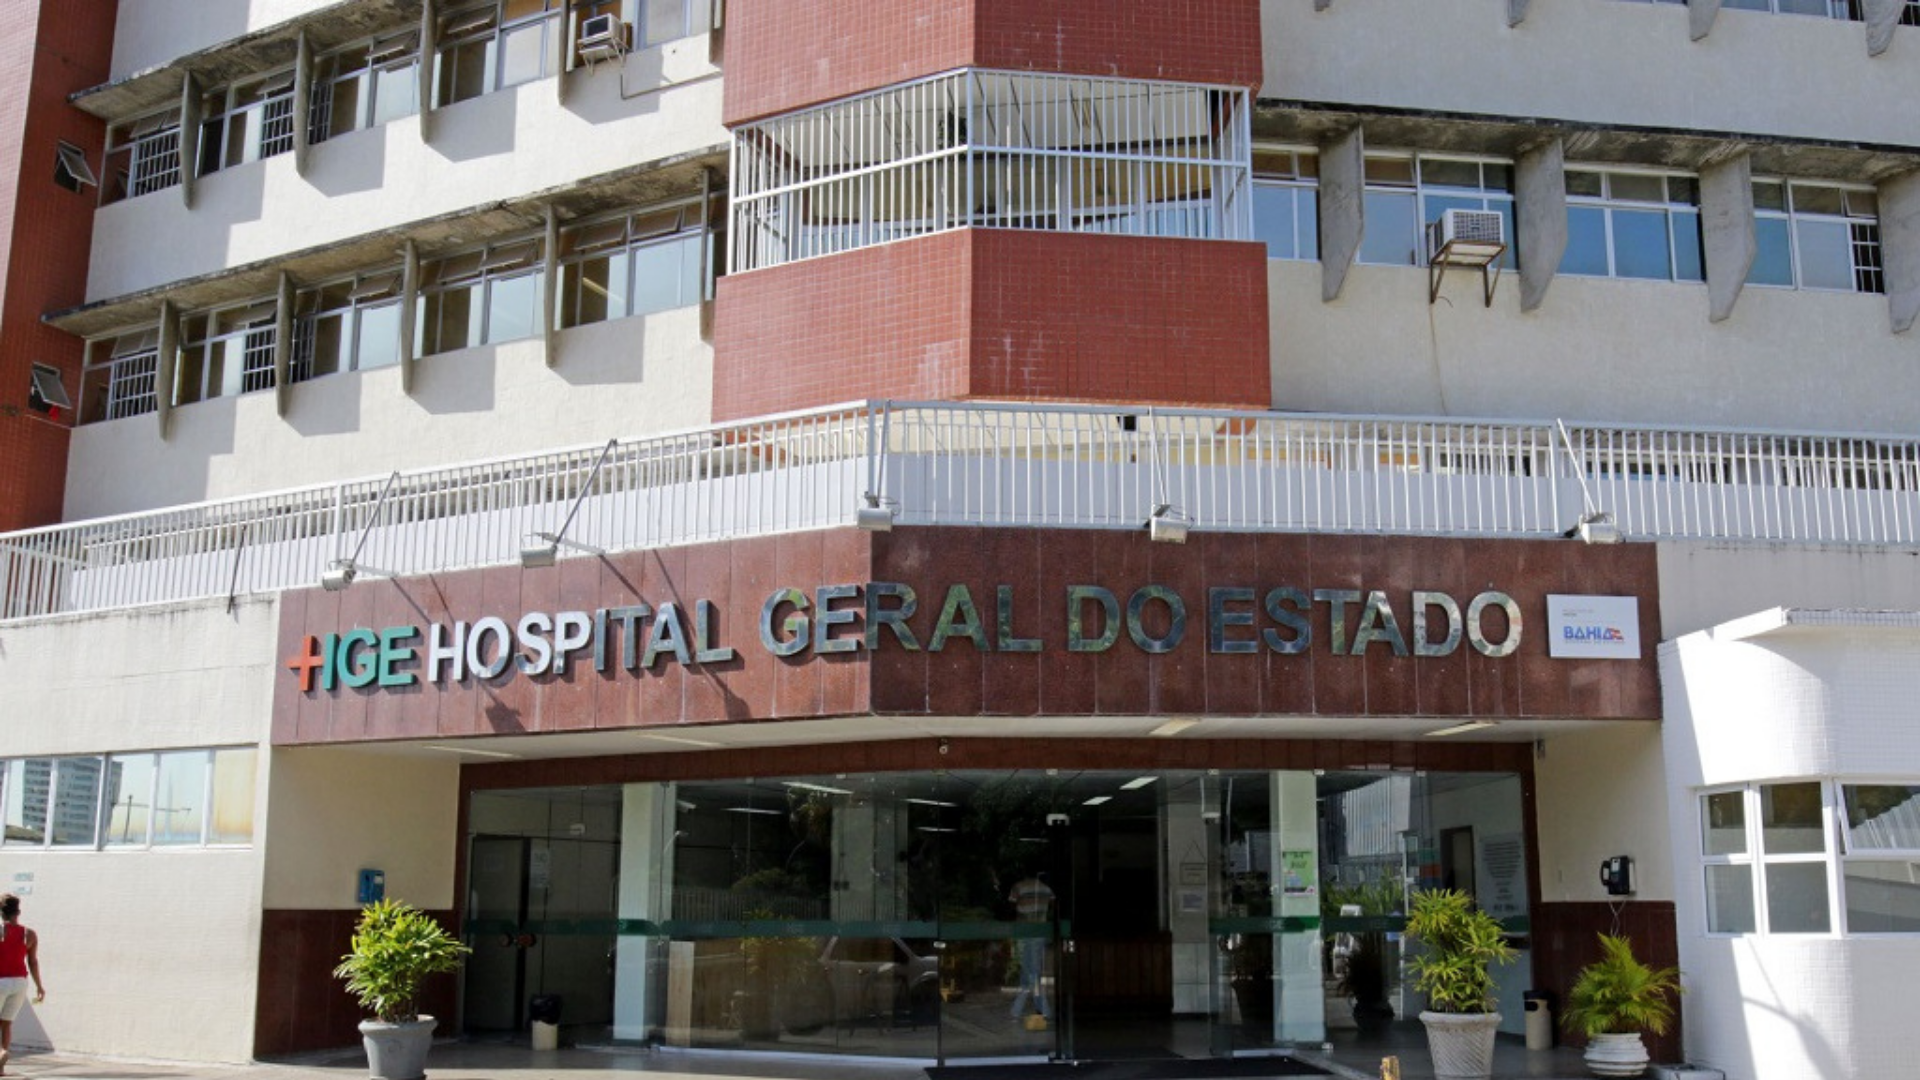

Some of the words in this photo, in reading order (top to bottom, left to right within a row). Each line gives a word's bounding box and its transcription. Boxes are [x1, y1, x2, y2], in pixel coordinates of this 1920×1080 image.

[427, 599, 733, 683] HOSPITAL
[759, 583, 1043, 656] GERAL
[1067, 584, 1186, 653] DO
[1209, 586, 1523, 657] ESTADO
[1563, 625, 1623, 640] BAHIA
